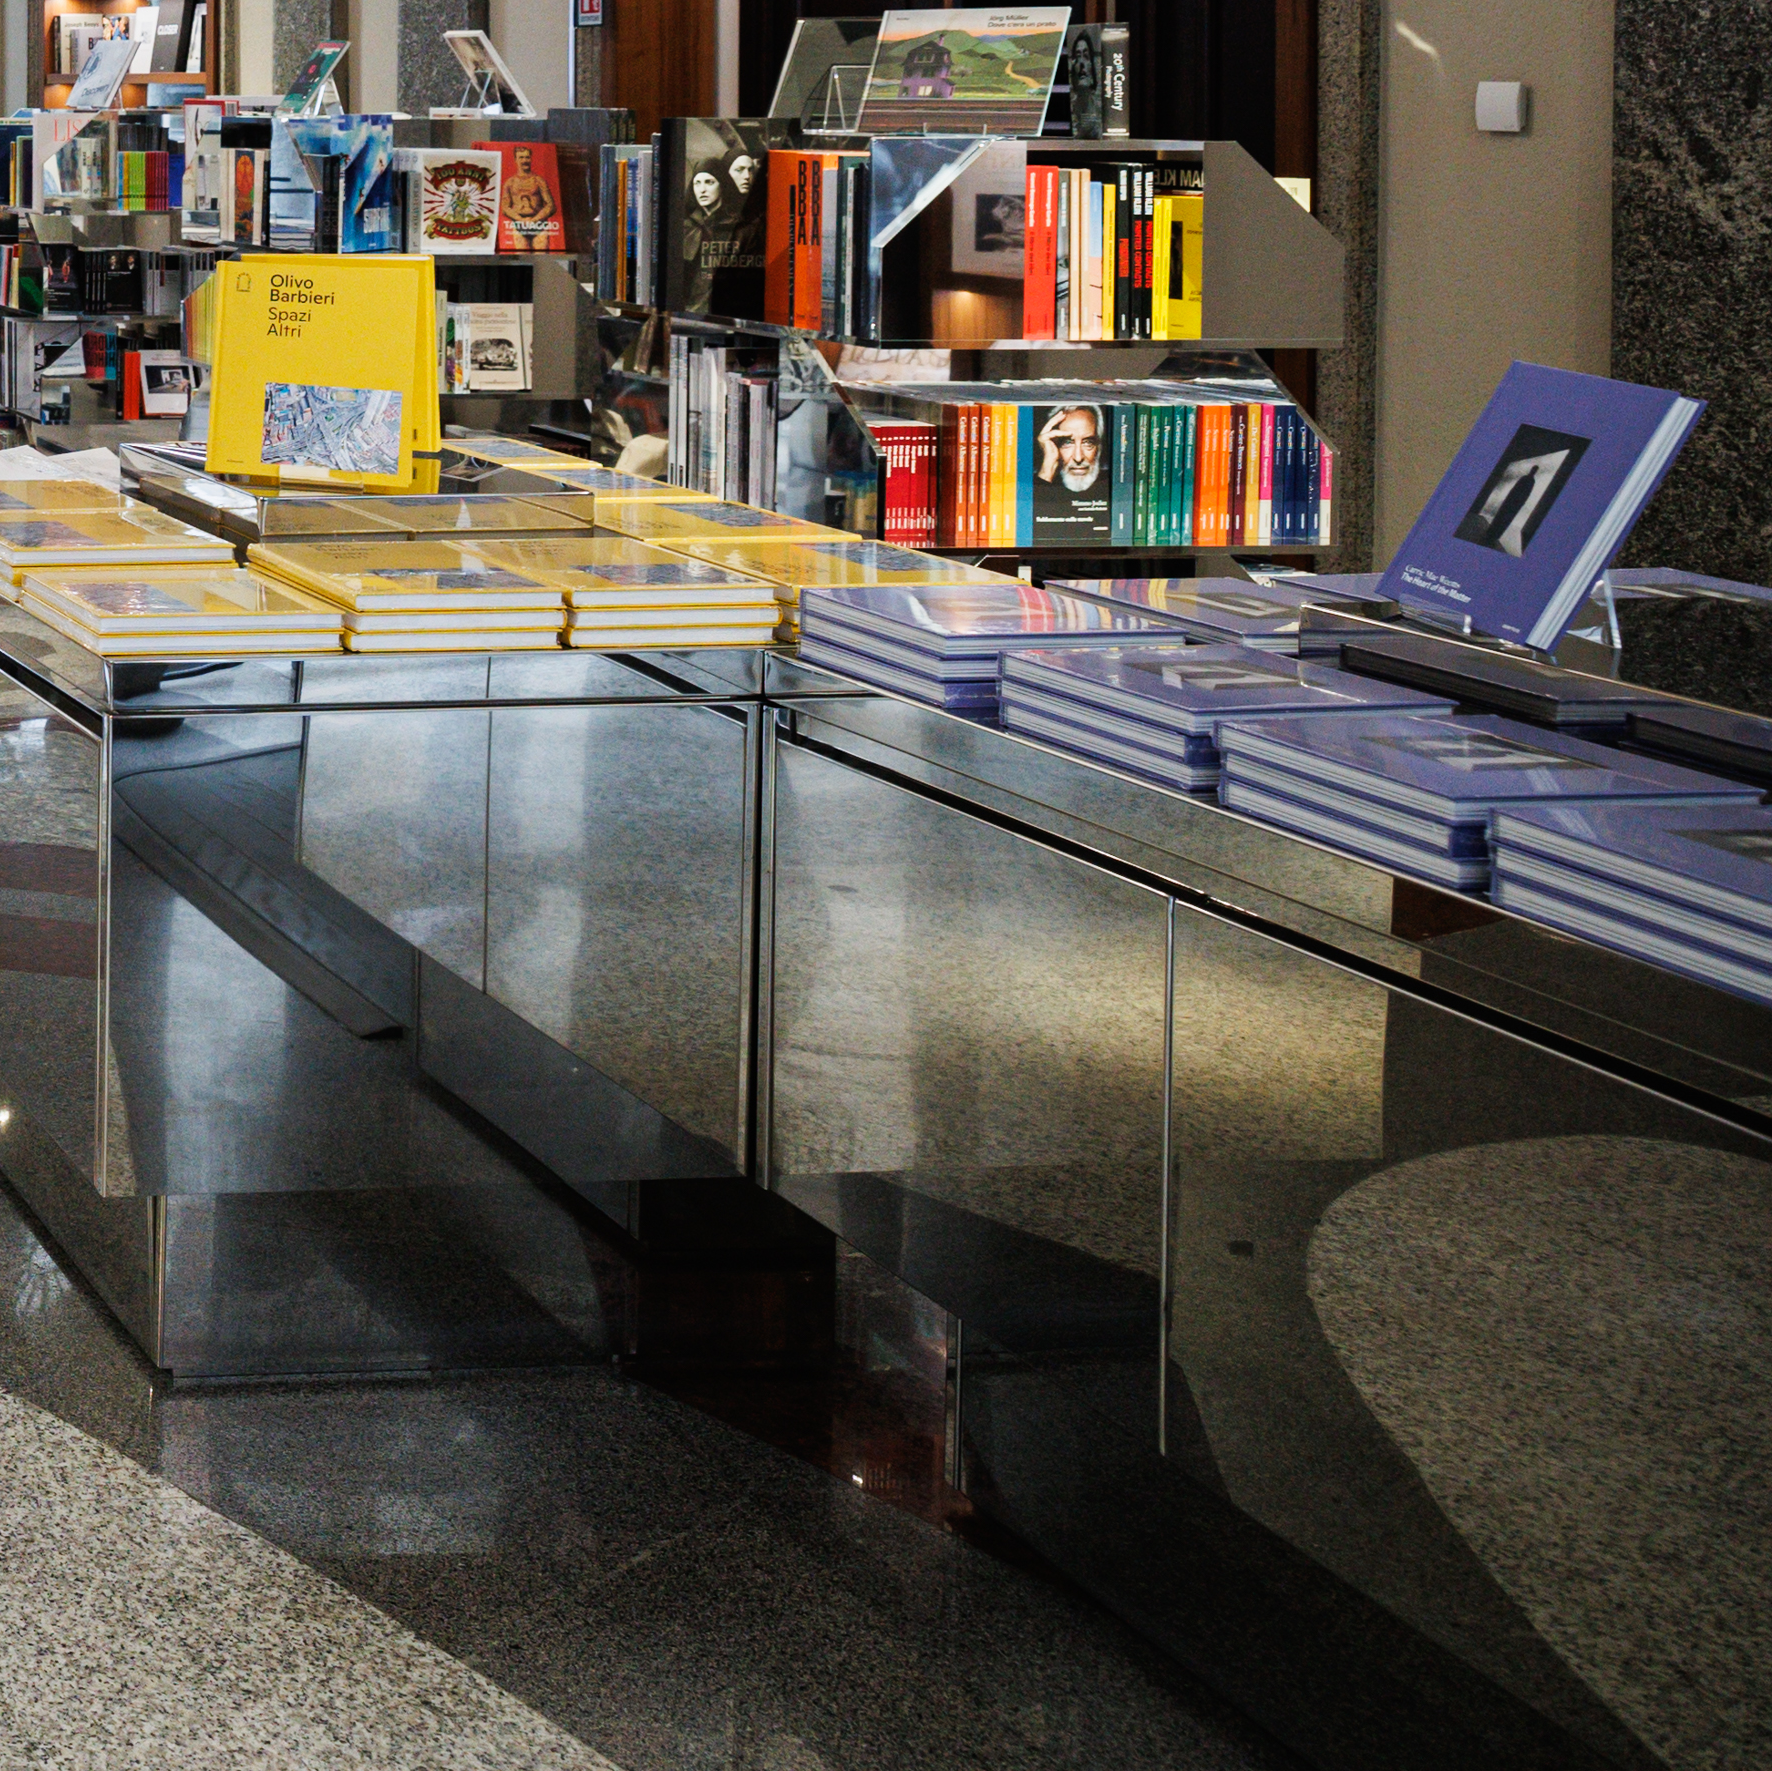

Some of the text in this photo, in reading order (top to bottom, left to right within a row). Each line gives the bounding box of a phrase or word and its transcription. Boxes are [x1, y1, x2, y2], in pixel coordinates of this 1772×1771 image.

[1112, 72, 1126, 111] Century
[503, 220, 560, 230] TATUAGGIO
[700, 241, 740, 255] PETER
[700, 255, 766, 268] LINDBERG
[270, 273, 314, 290] Olivo
[269, 288, 335, 305] Barbieri
[268, 307, 311, 323] Spazi
[266, 323, 302, 338] Altri
[1405, 564, 1461, 588] Carrie Mae Weems
[1401, 572, 1413, 583] The
[1413, 576, 1432, 589] Heart
[1437, 585, 1449, 595] the
[1448, 589, 1472, 603] Matter
